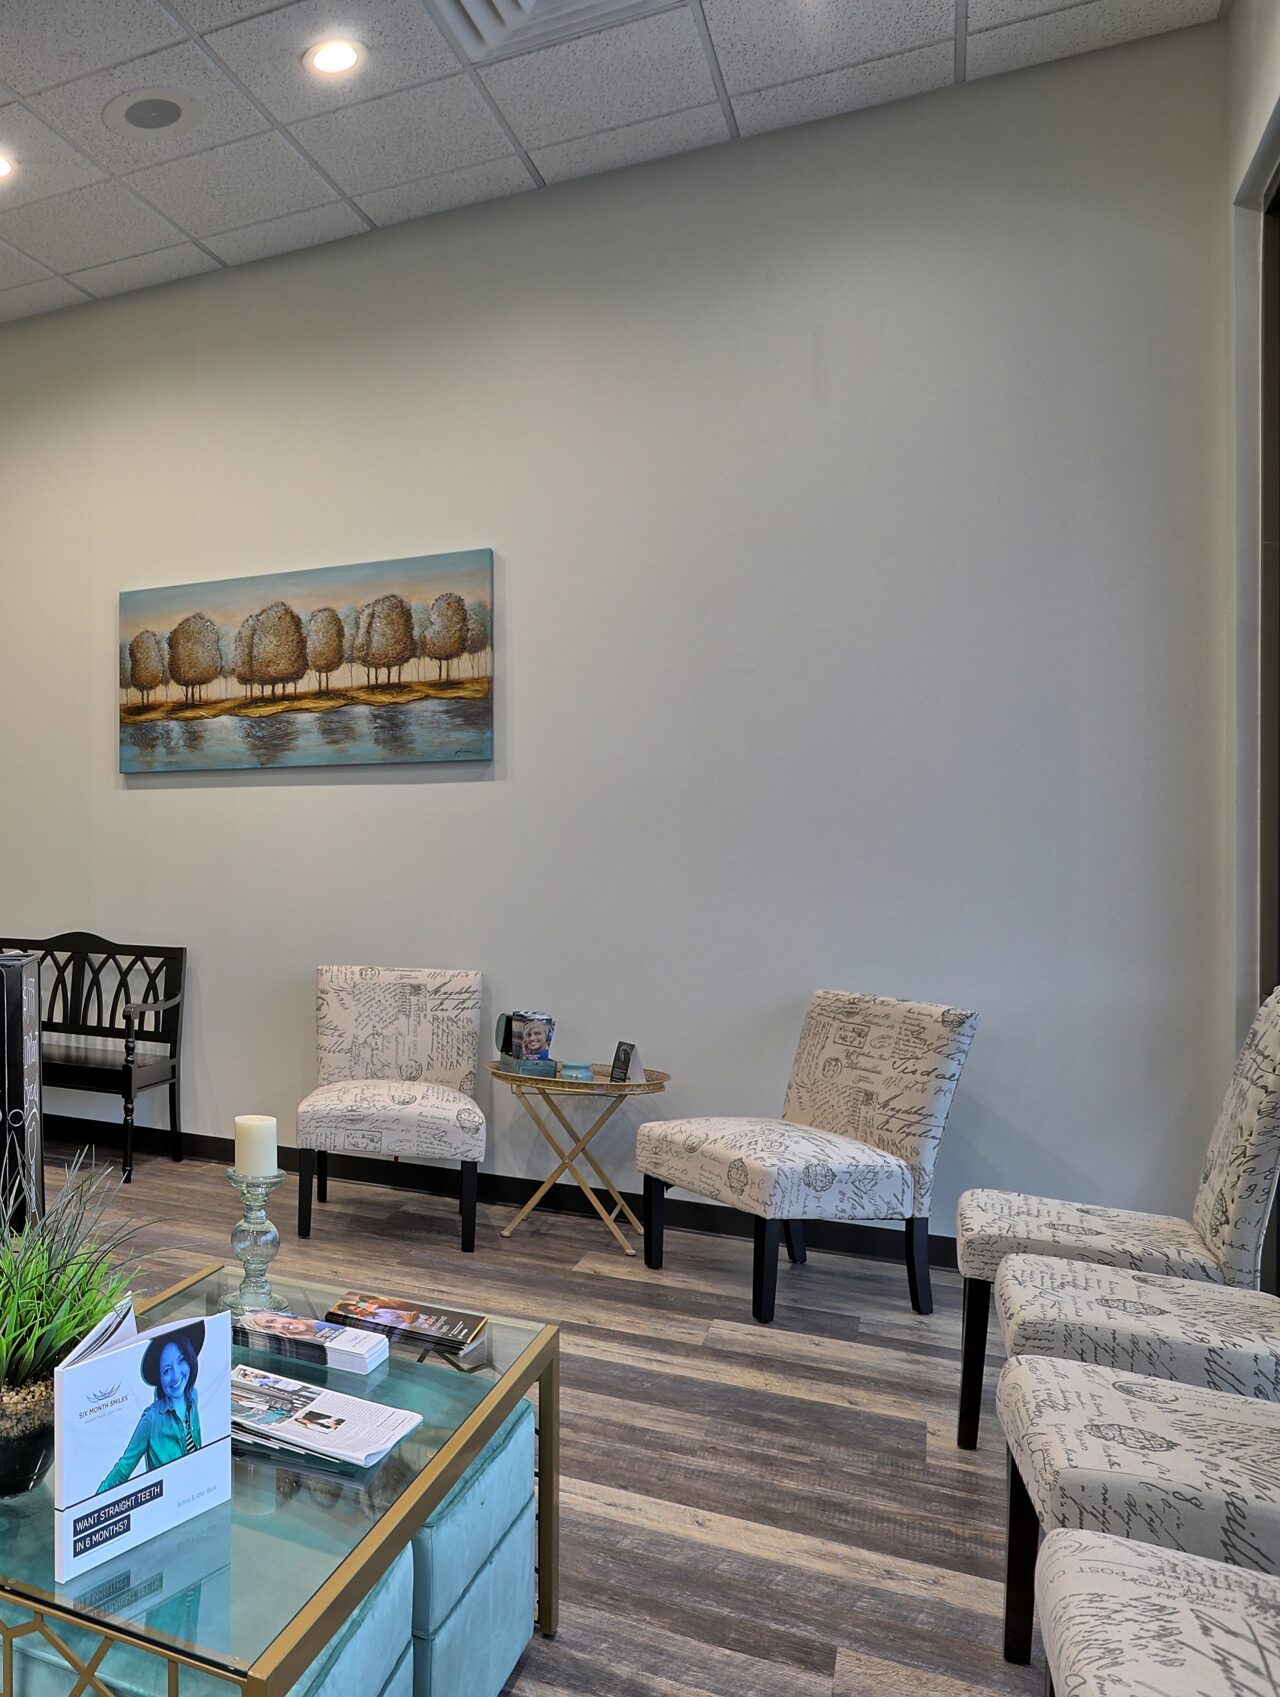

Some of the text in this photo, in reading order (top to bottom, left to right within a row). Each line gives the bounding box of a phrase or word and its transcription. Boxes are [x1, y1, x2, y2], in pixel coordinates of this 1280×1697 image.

[78, 1410, 88, 1419] SIX
[89, 1402, 109, 1415] MONTH
[75, 1484, 161, 1532] WANT STRAIGHT TEETH
[76, 1519, 128, 1552] IN 6 MONTHS?
